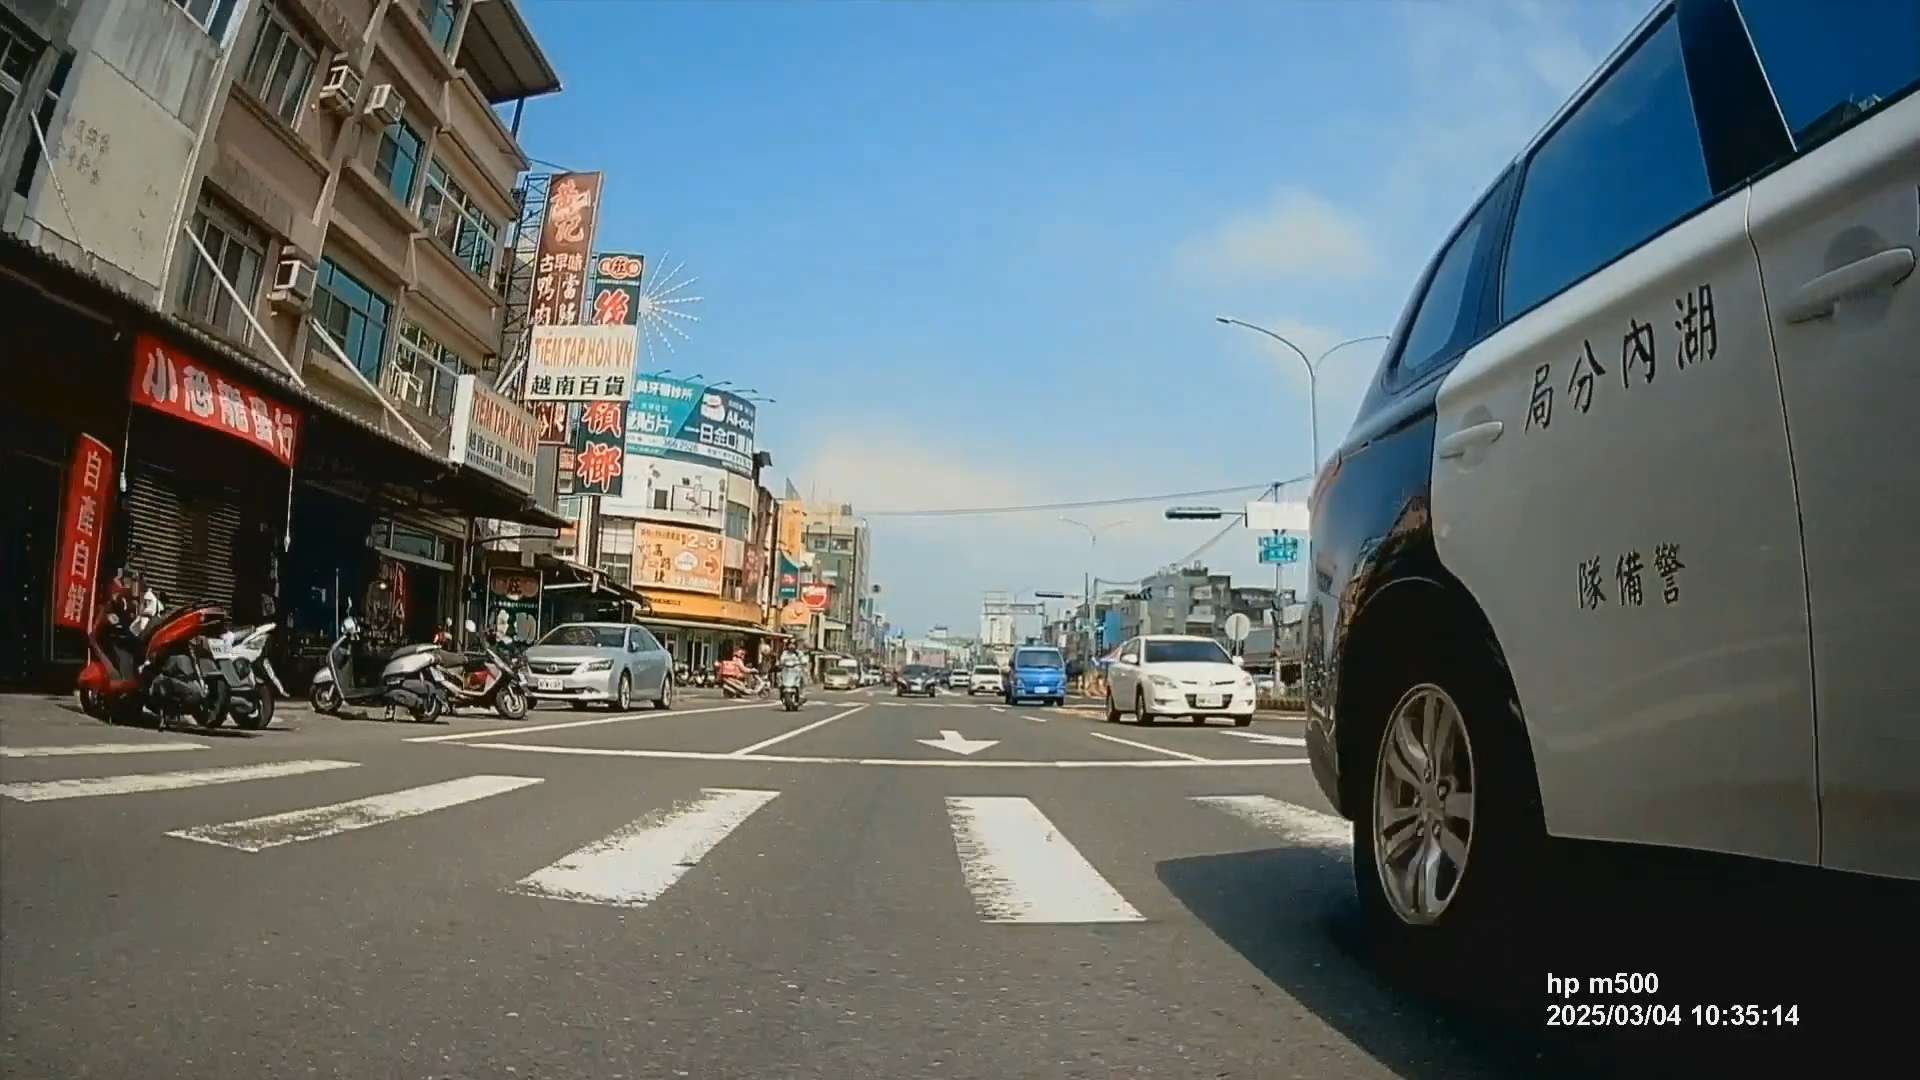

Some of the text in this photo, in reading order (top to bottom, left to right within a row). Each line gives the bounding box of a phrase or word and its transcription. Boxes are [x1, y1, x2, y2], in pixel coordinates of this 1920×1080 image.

[540, 253, 583, 273] 古早味
[531, 375, 625, 396] 越南百貨
[64, 450, 102, 623] 自產自銷
